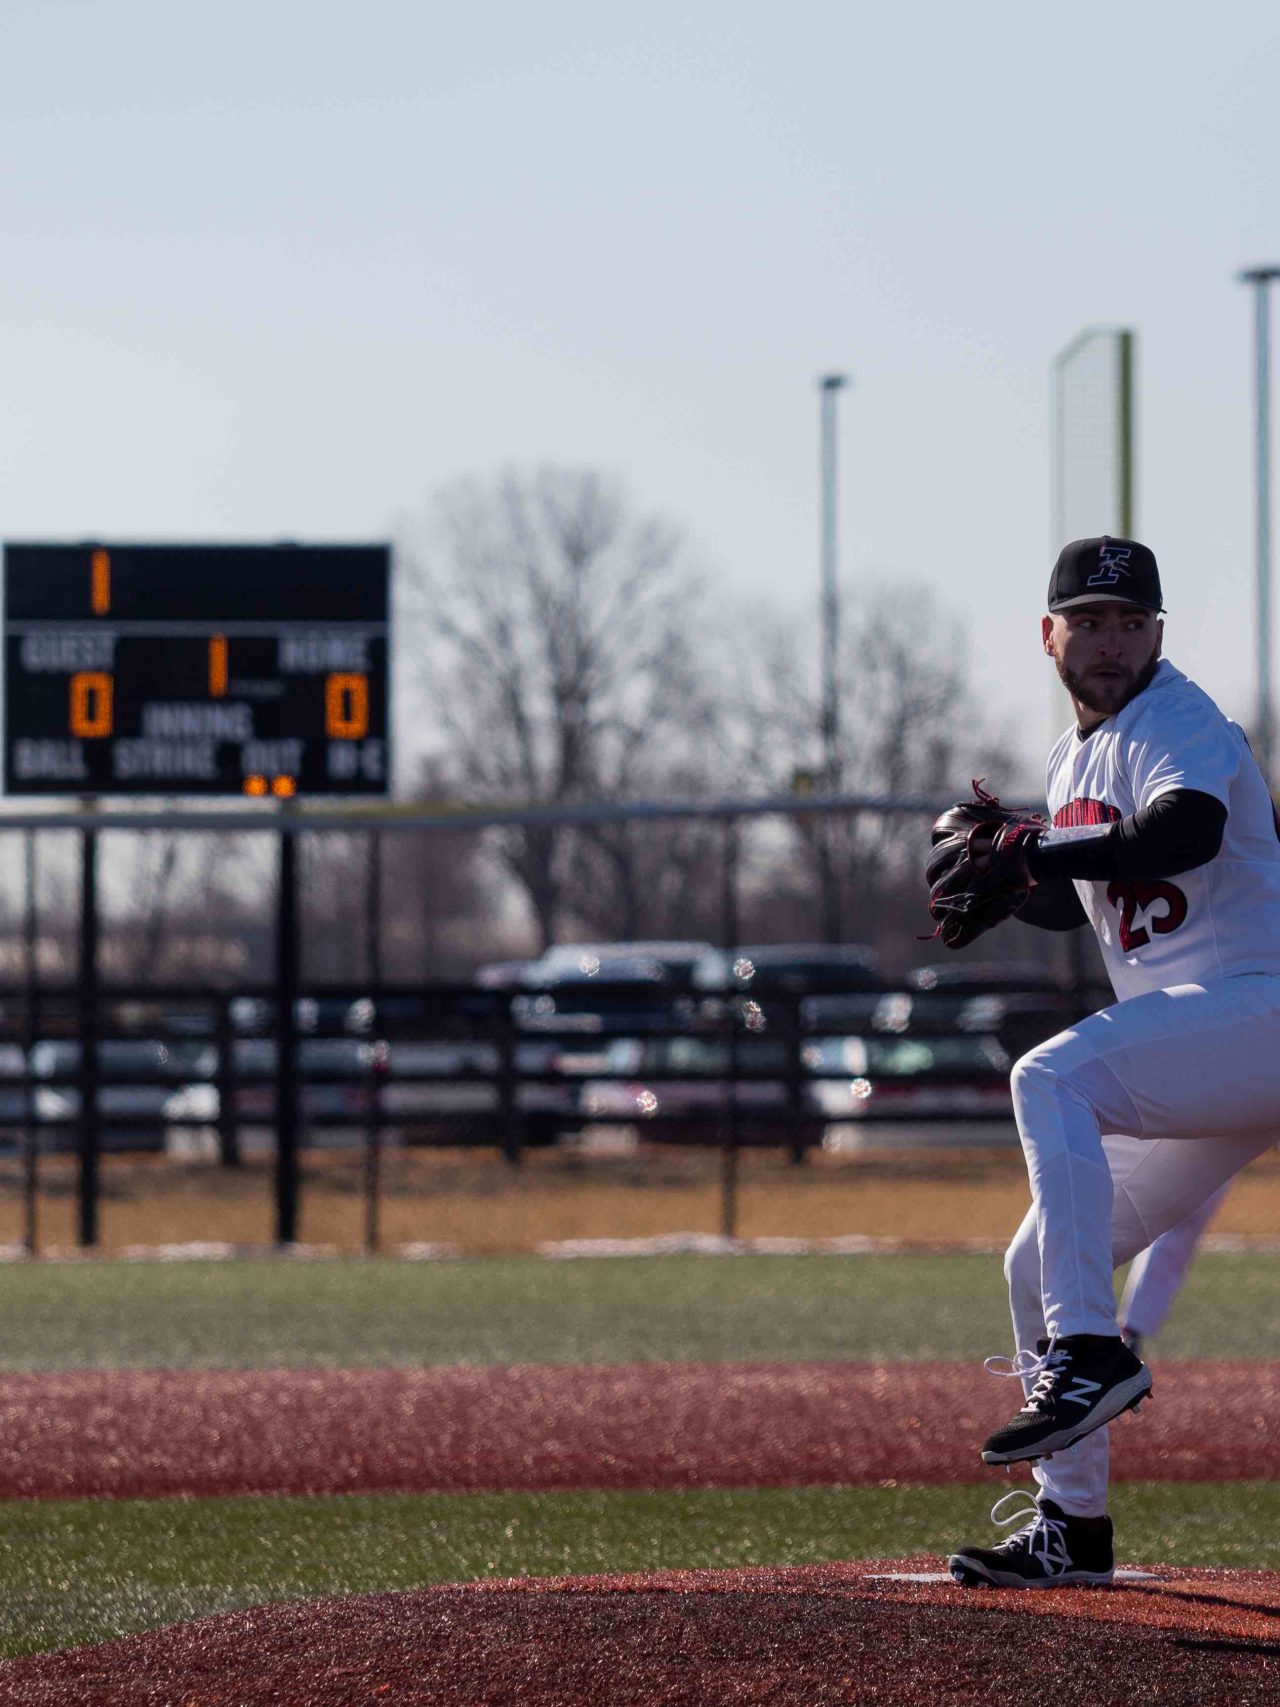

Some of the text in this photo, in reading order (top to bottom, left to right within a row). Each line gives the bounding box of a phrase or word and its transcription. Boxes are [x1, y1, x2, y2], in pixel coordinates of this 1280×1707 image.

[209, 633, 228, 698] 1
[70, 672, 113, 738] 0
[142, 703, 254, 738] INNING
[326, 672, 368, 739] 0
[14, 739, 87, 779] BALL
[114, 739, 216, 779] STRIKE
